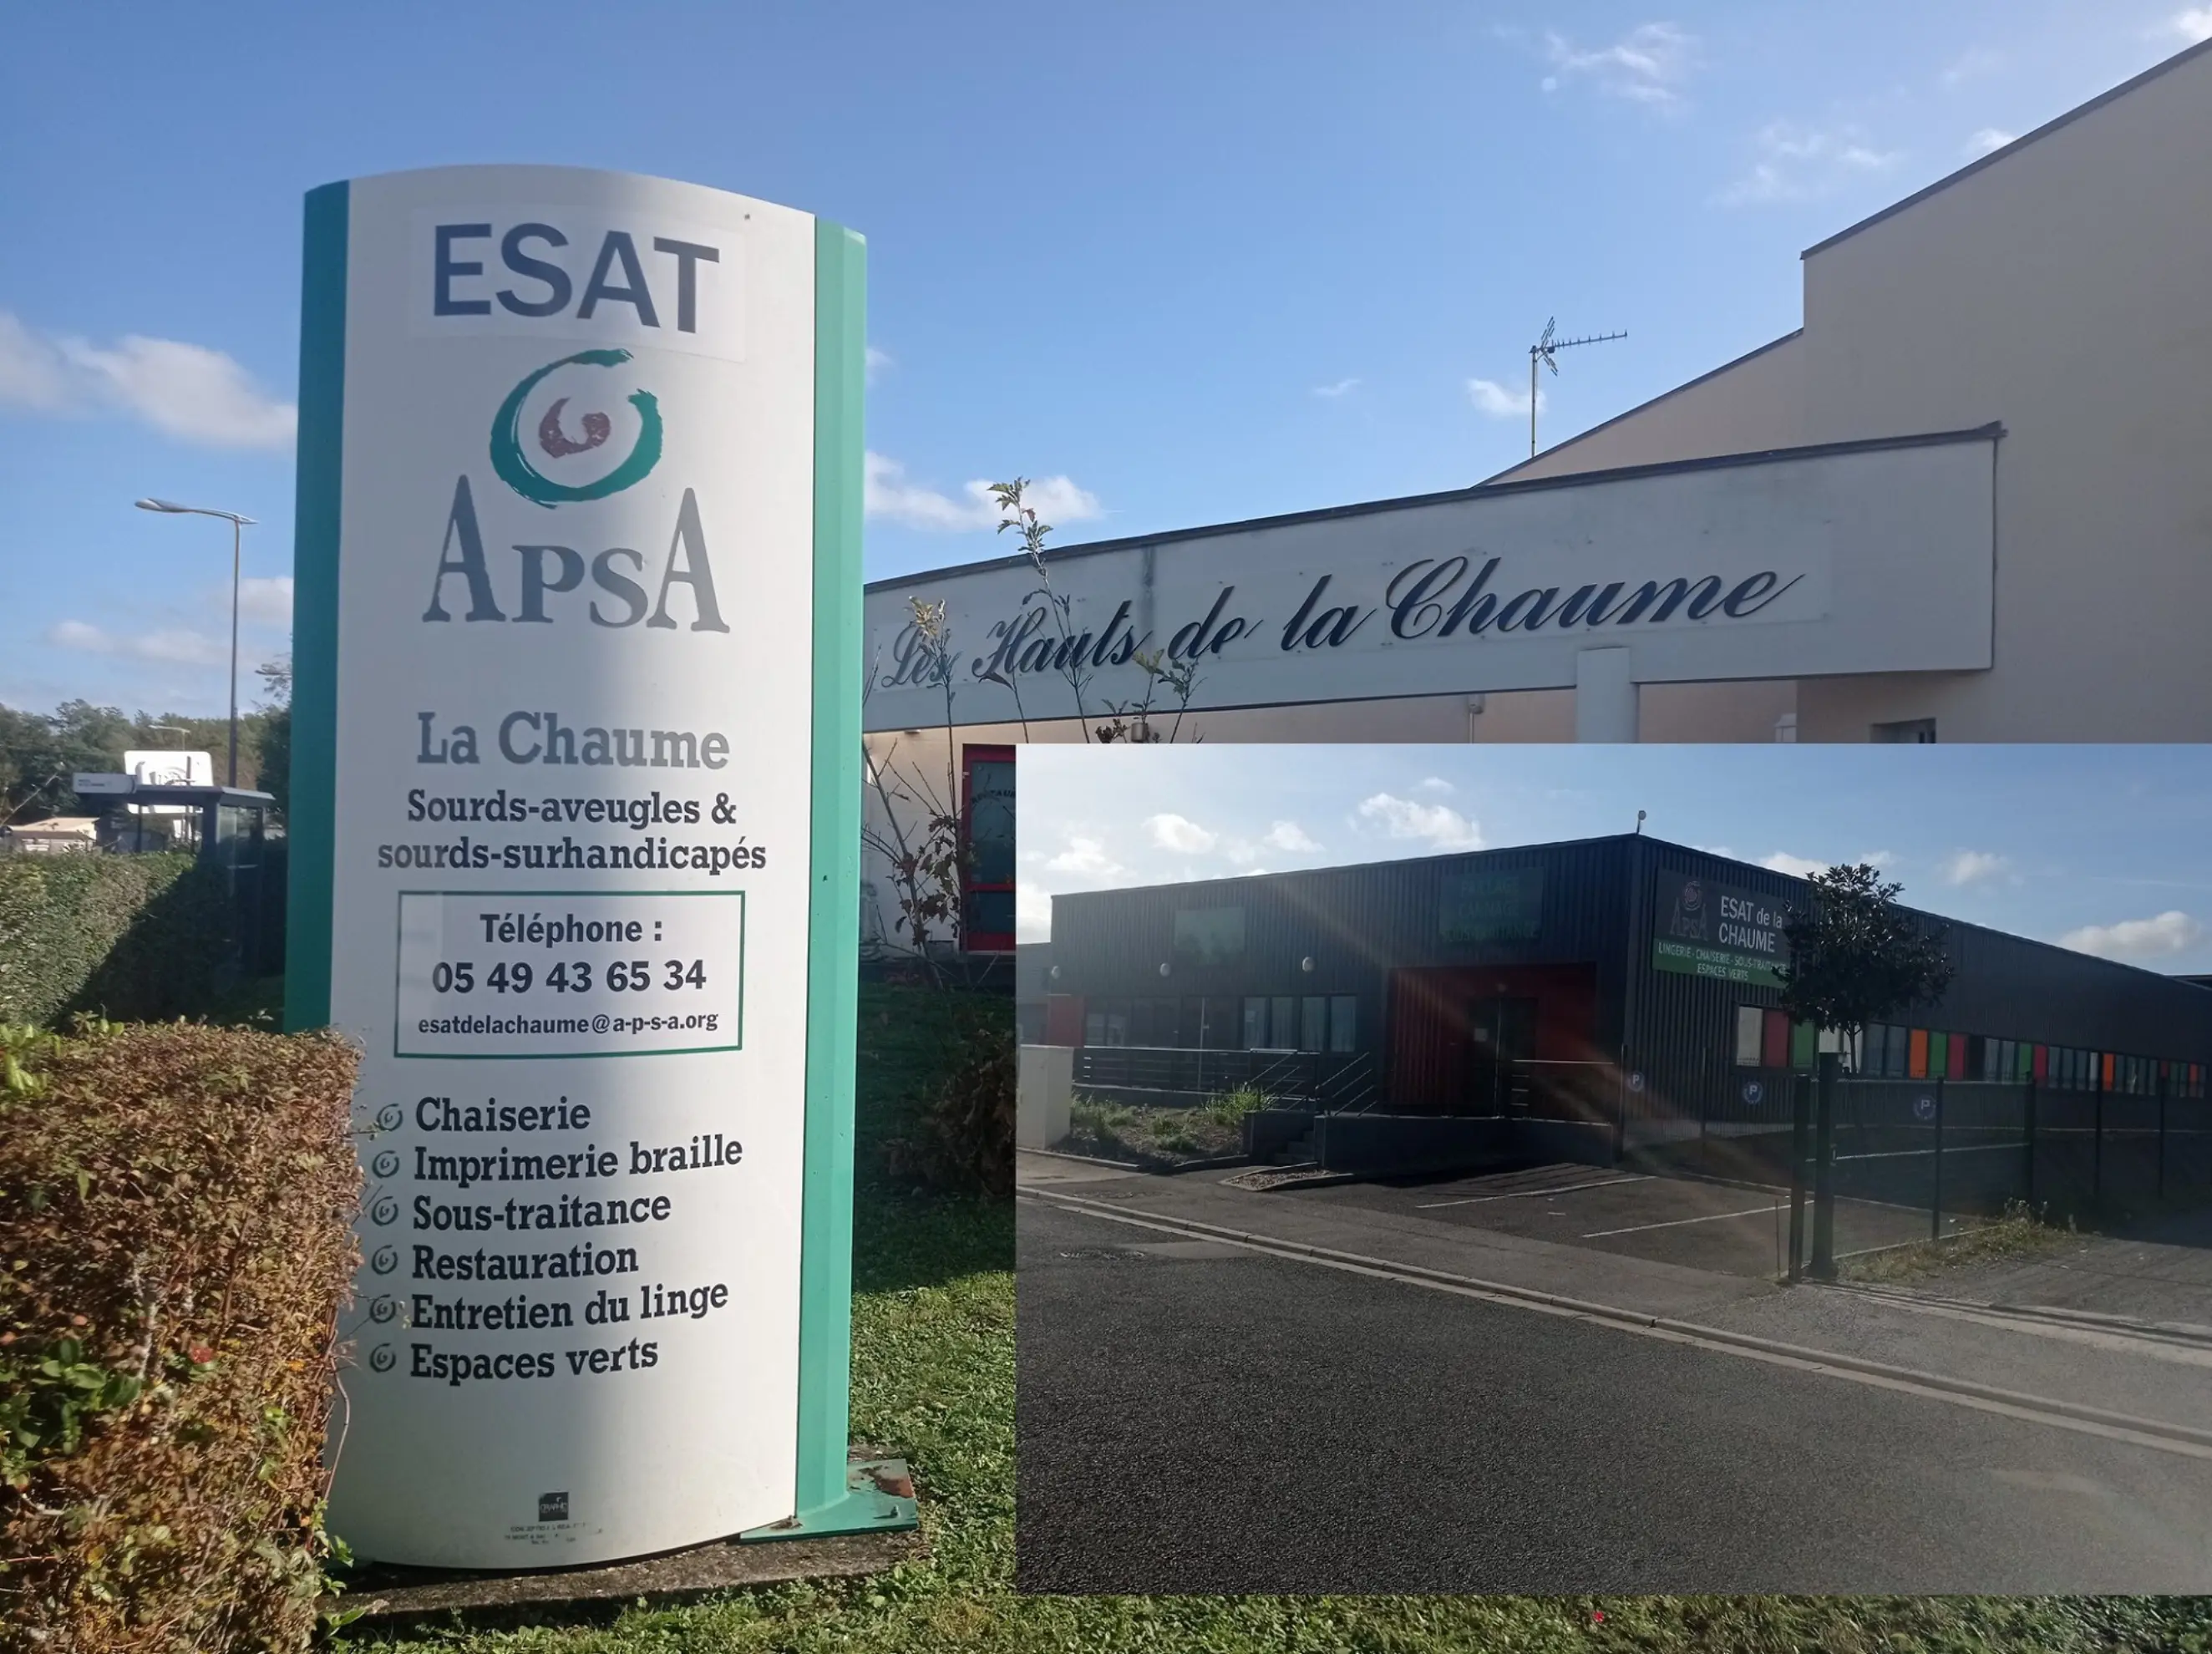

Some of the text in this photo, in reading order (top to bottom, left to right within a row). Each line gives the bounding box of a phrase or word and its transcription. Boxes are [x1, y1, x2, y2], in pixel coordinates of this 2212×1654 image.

[434, 222, 720, 334] ESAT
[972, 600, 1154, 677] Hauts
[1167, 586, 1263, 660] de
[1280, 574, 1377, 652] la
[1385, 556, 1806, 641] Chaume
[417, 710, 730, 770] La Chaume
[408, 789, 738, 830] Sourds-aveugles &
[378, 837, 767, 875] sourds-surhandicapés
[479, 913, 642, 948] Téléphone
[1721, 895, 1783, 929] ESAT de la
[1658, 941, 1692, 959] LINGERIE
[1696, 948, 1730, 965] CHAISERIE
[1718, 922, 1776, 953] CHAUME
[432, 959, 707, 993] 05 49 43 65 34
[1697, 962, 1749, 981] ESPACES VERTS
[419, 1012, 718, 1036] esatdelachaume@a-p-s-a.org
[415, 1096, 591, 1132] Chaiserie
[413, 1134, 743, 1189] Imprimerie braille
[413, 1195, 672, 1231] Sous-traitance
[412, 1241, 639, 1281] Restauration
[410, 1282, 729, 1330] Entretien du linge
[409, 1337, 659, 1387] Espaces verts
